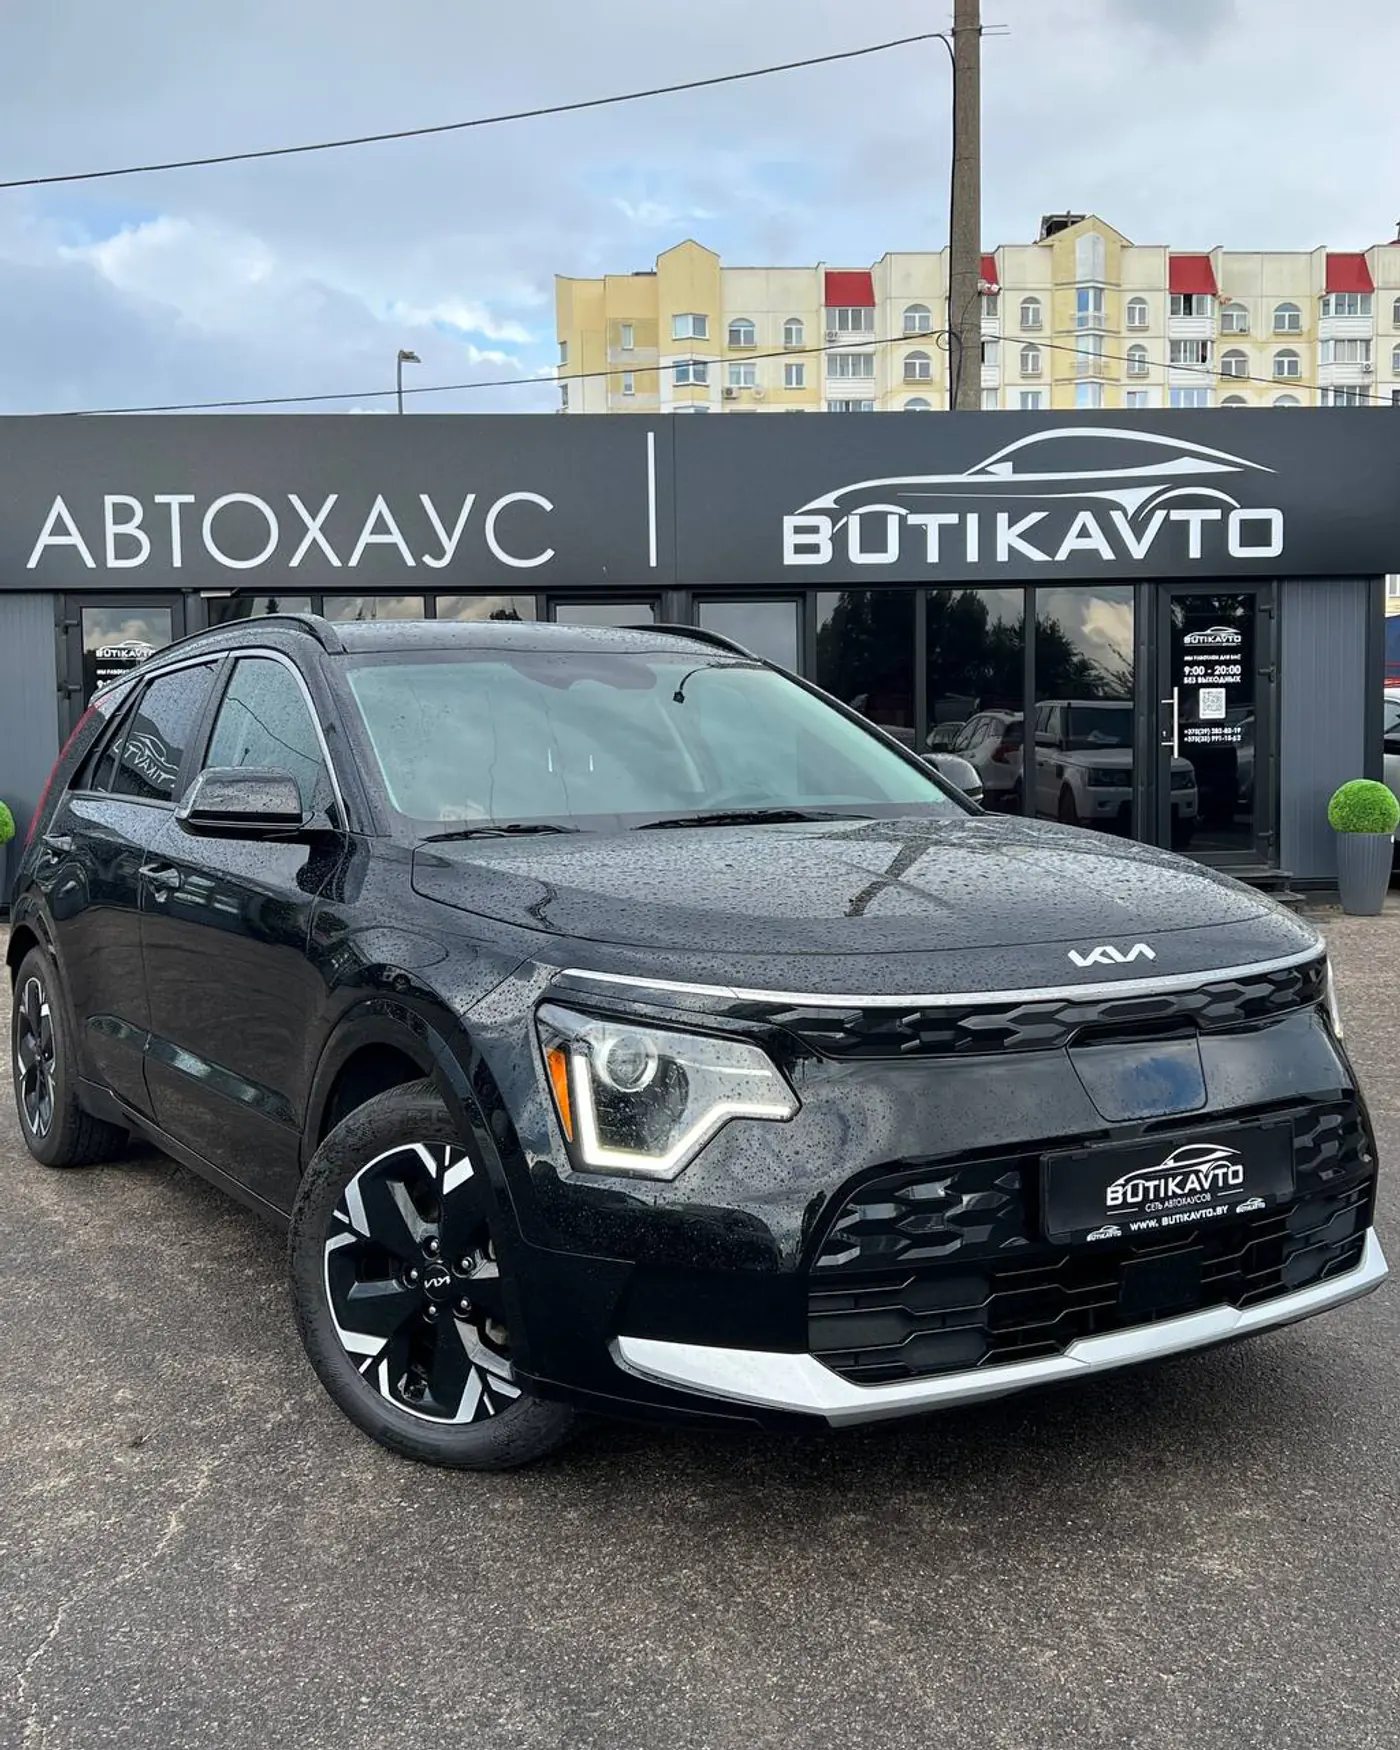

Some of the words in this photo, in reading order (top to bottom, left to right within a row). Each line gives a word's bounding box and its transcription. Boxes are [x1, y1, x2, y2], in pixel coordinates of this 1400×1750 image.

[26, 491, 556, 569] АВТОХАУС
[783, 508, 1284, 566] BUTIKAVTO
[1183, 635, 1242, 644] BUTIKAVTO
[95, 649, 157, 658] BUTIKAVT
[1184, 666, 1205, 676] 9:00
[1214, 665, 1242, 675] 20:00
[1197, 675, 1241, 684] ВЫХОДНЫХ
[1106, 1164, 1244, 1207] BUTIKAVTO
[1145, 1201, 1163, 1212] СЕТЬ
[1163, 1192, 1212, 1209] АВТОХАУСОВ
[1161, 1204, 1229, 1226] BUTIKAVTO.BY
